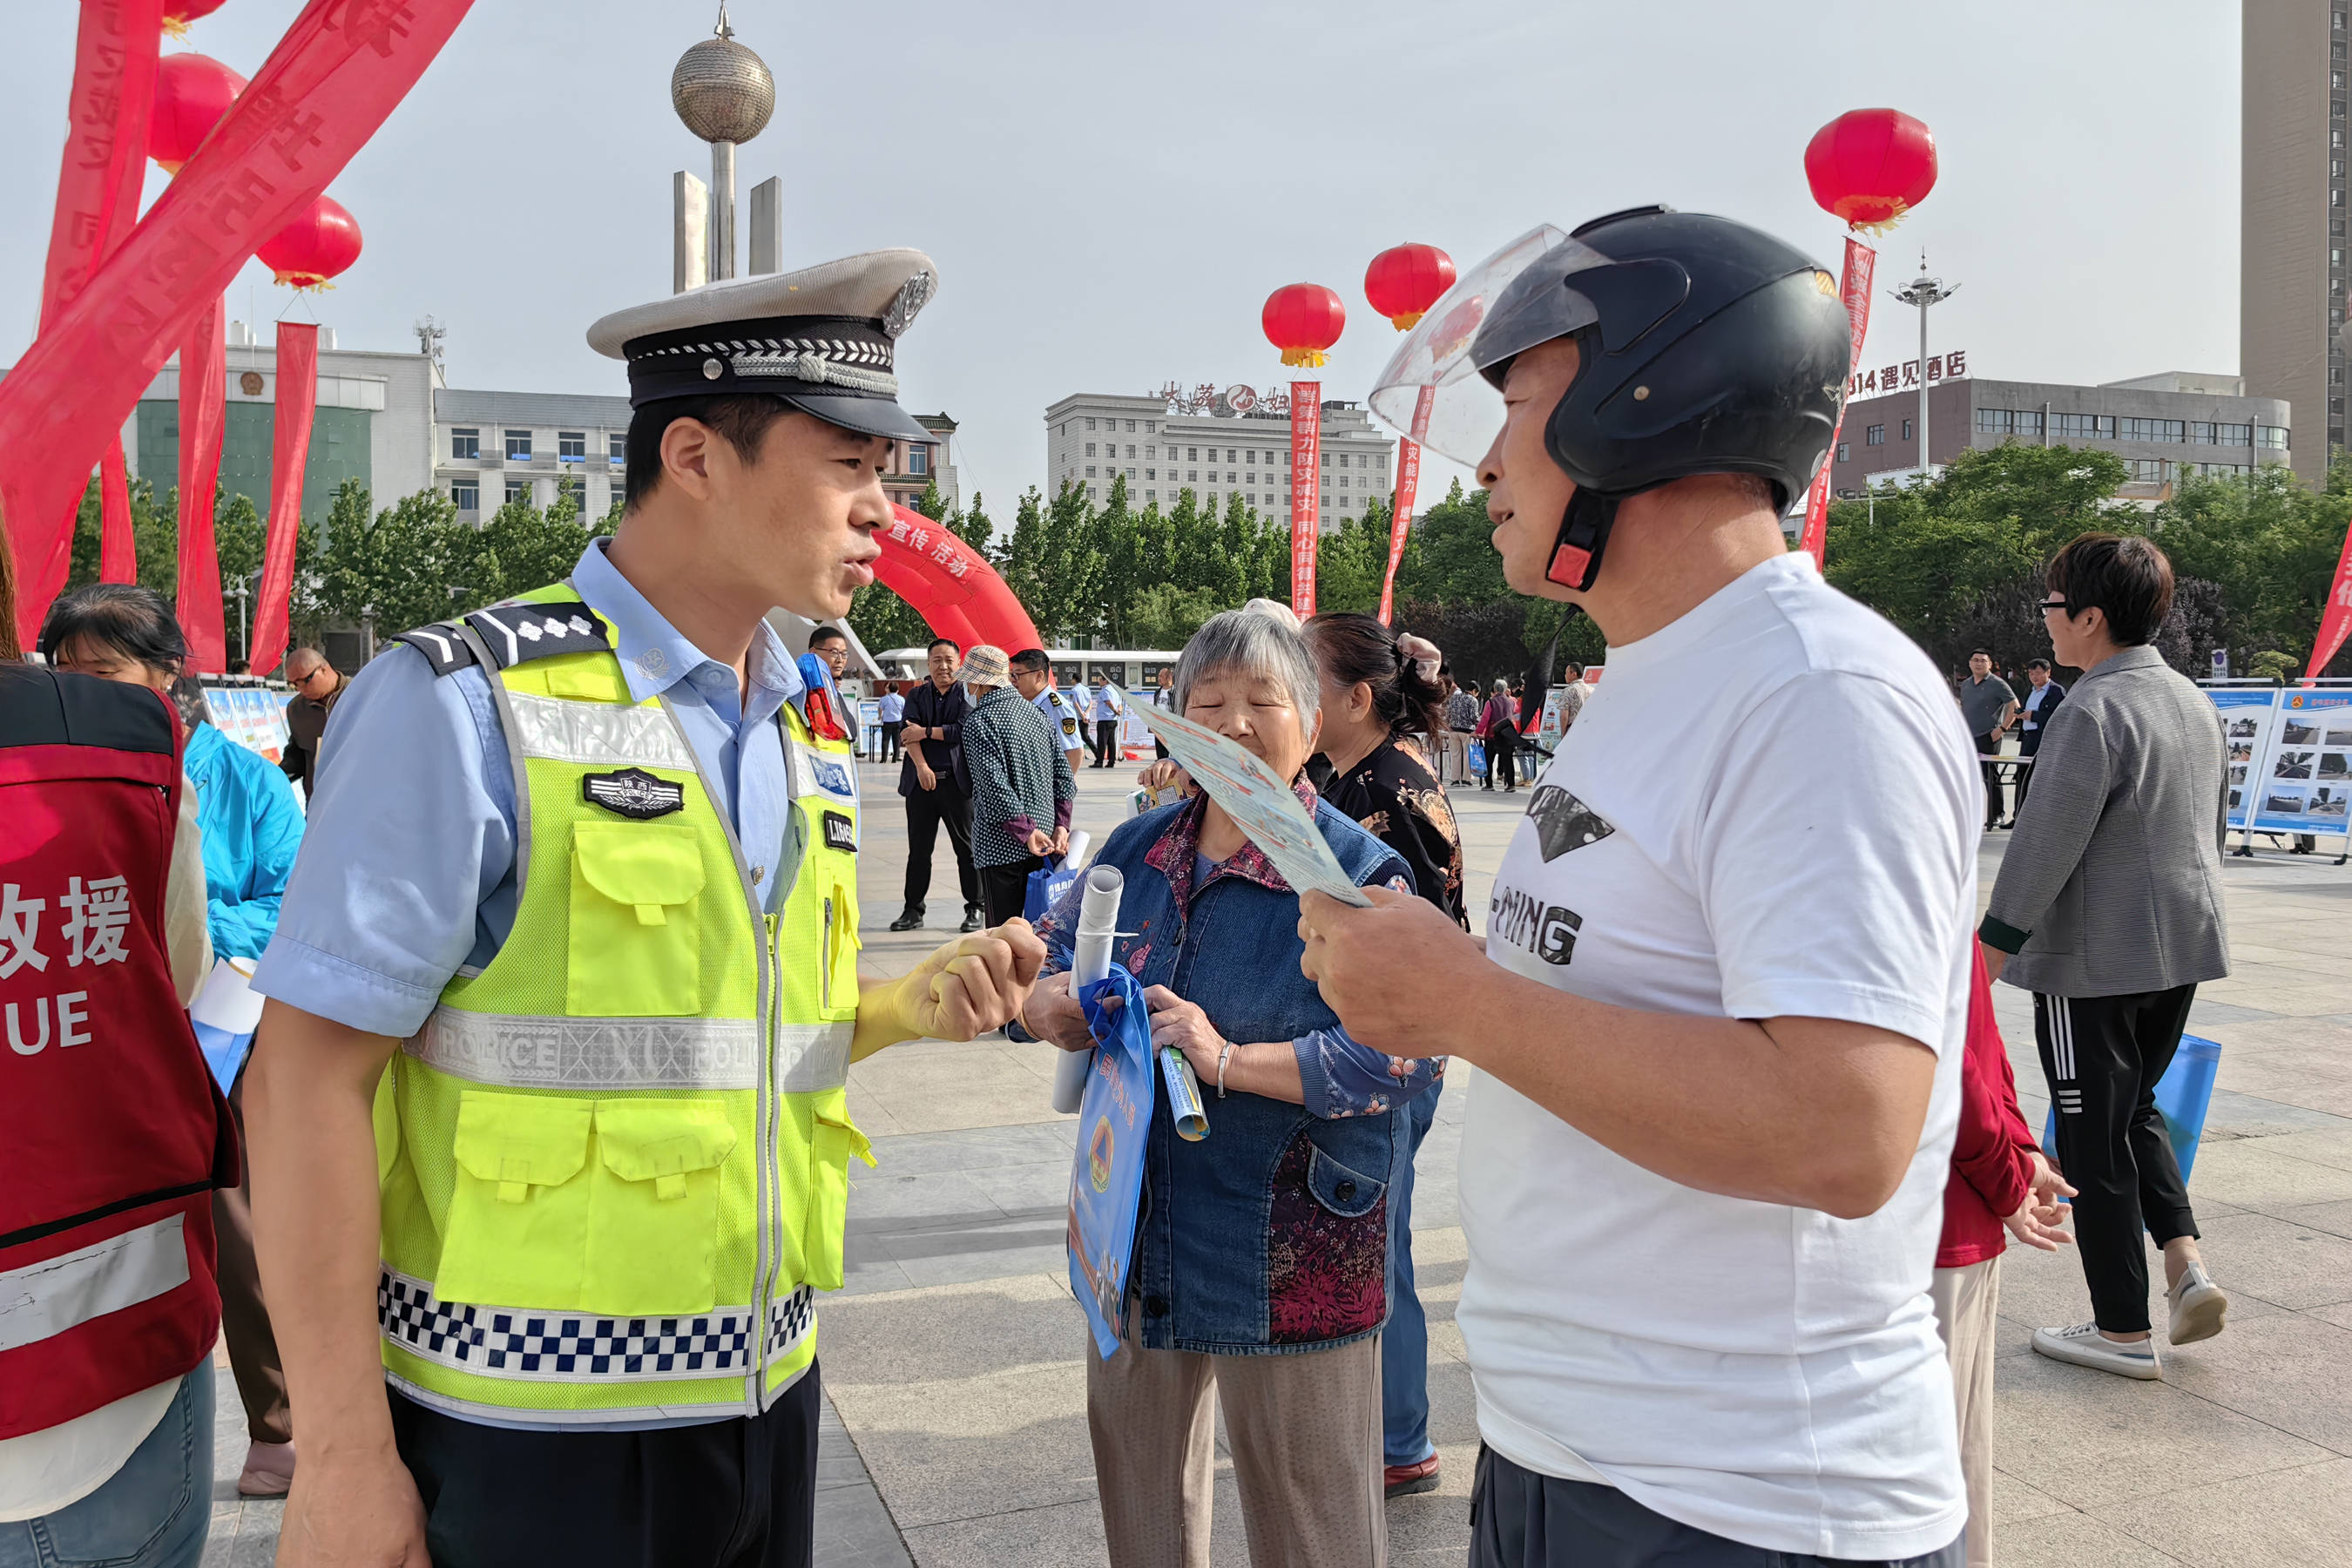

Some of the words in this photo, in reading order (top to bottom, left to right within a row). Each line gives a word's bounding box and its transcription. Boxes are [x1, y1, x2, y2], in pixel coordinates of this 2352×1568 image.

[1296, 389, 1316, 512] 群策群力防灾减灾
[623, 789, 652, 800] POLICE
[624, 779, 648, 791] 陕西
[5, 990, 91, 1056] UE
